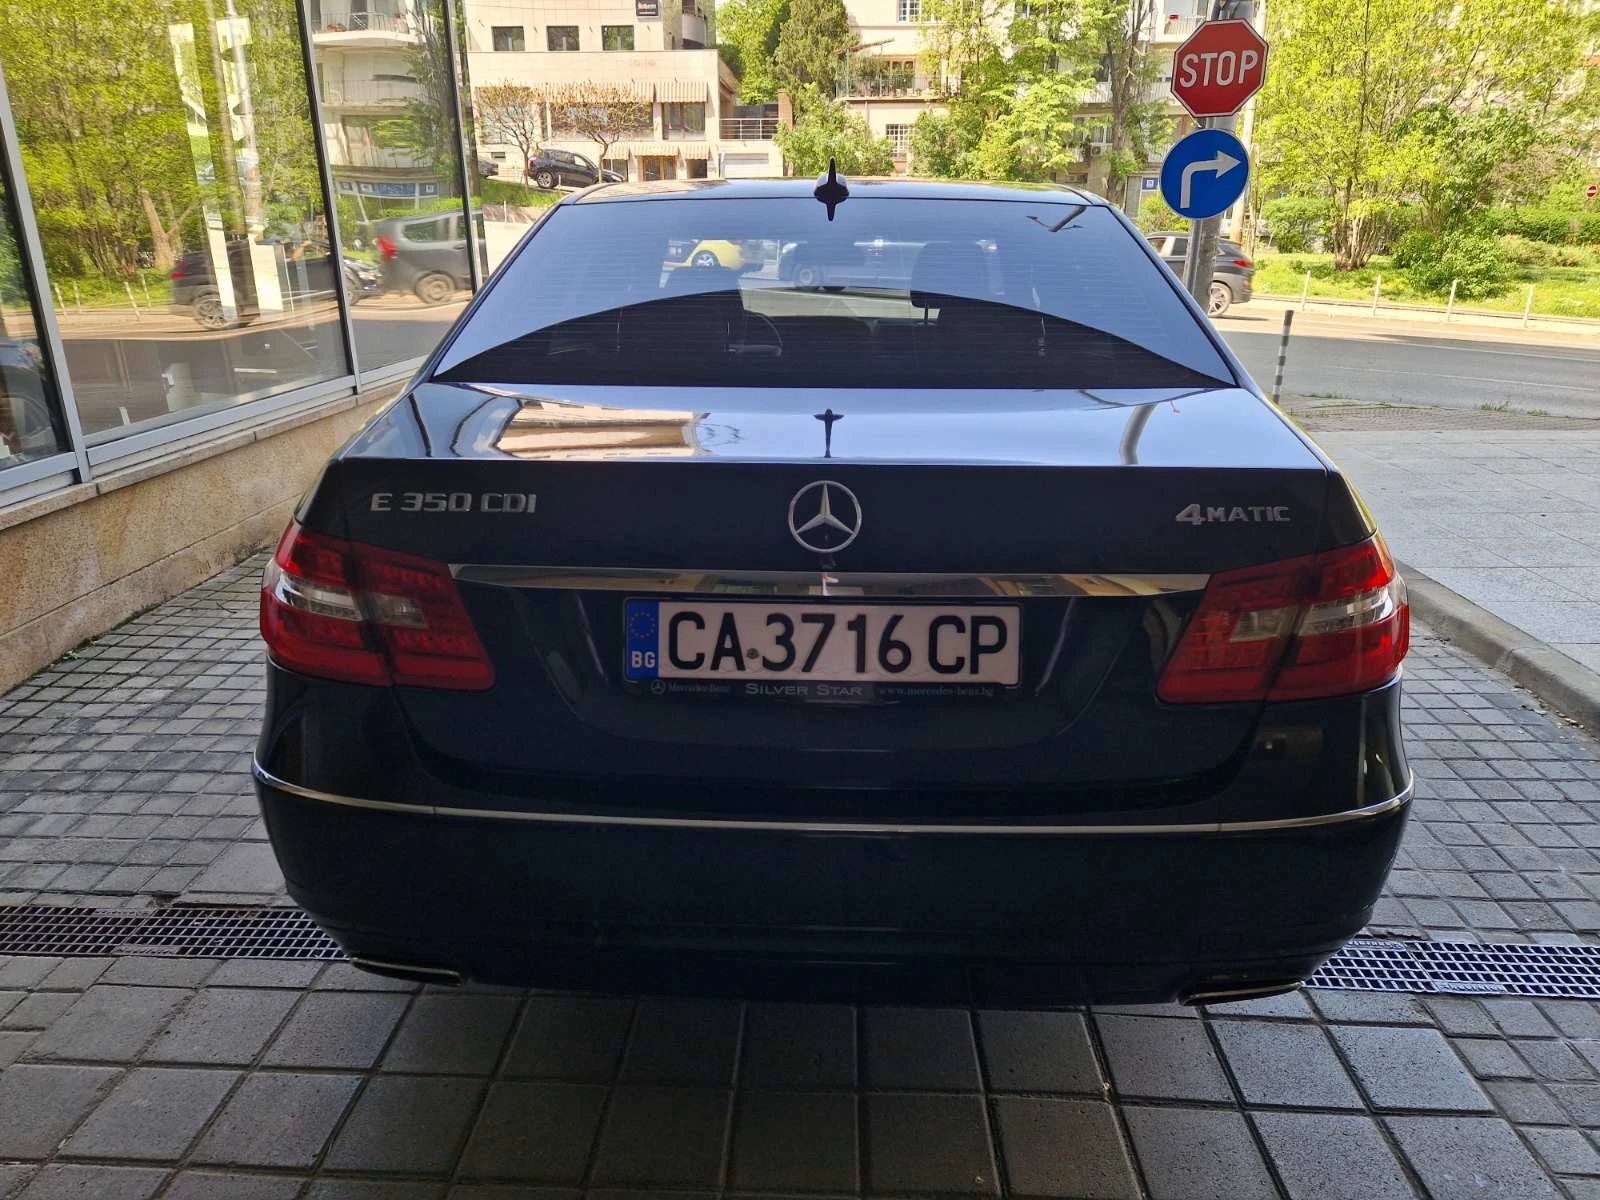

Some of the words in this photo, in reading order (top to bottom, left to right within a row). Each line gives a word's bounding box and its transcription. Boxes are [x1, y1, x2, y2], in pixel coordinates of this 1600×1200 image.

[1180, 50, 1258, 88] STOP
[370, 493, 393, 511] E
[400, 493, 472, 512] 350
[480, 493, 537, 513] CDI
[1175, 503, 1291, 525] 4MATIC
[668, 611, 746, 672] CA
[762, 613, 912, 673] 3716
[928, 615, 1008, 674] CP
[631, 651, 656, 668] BG
